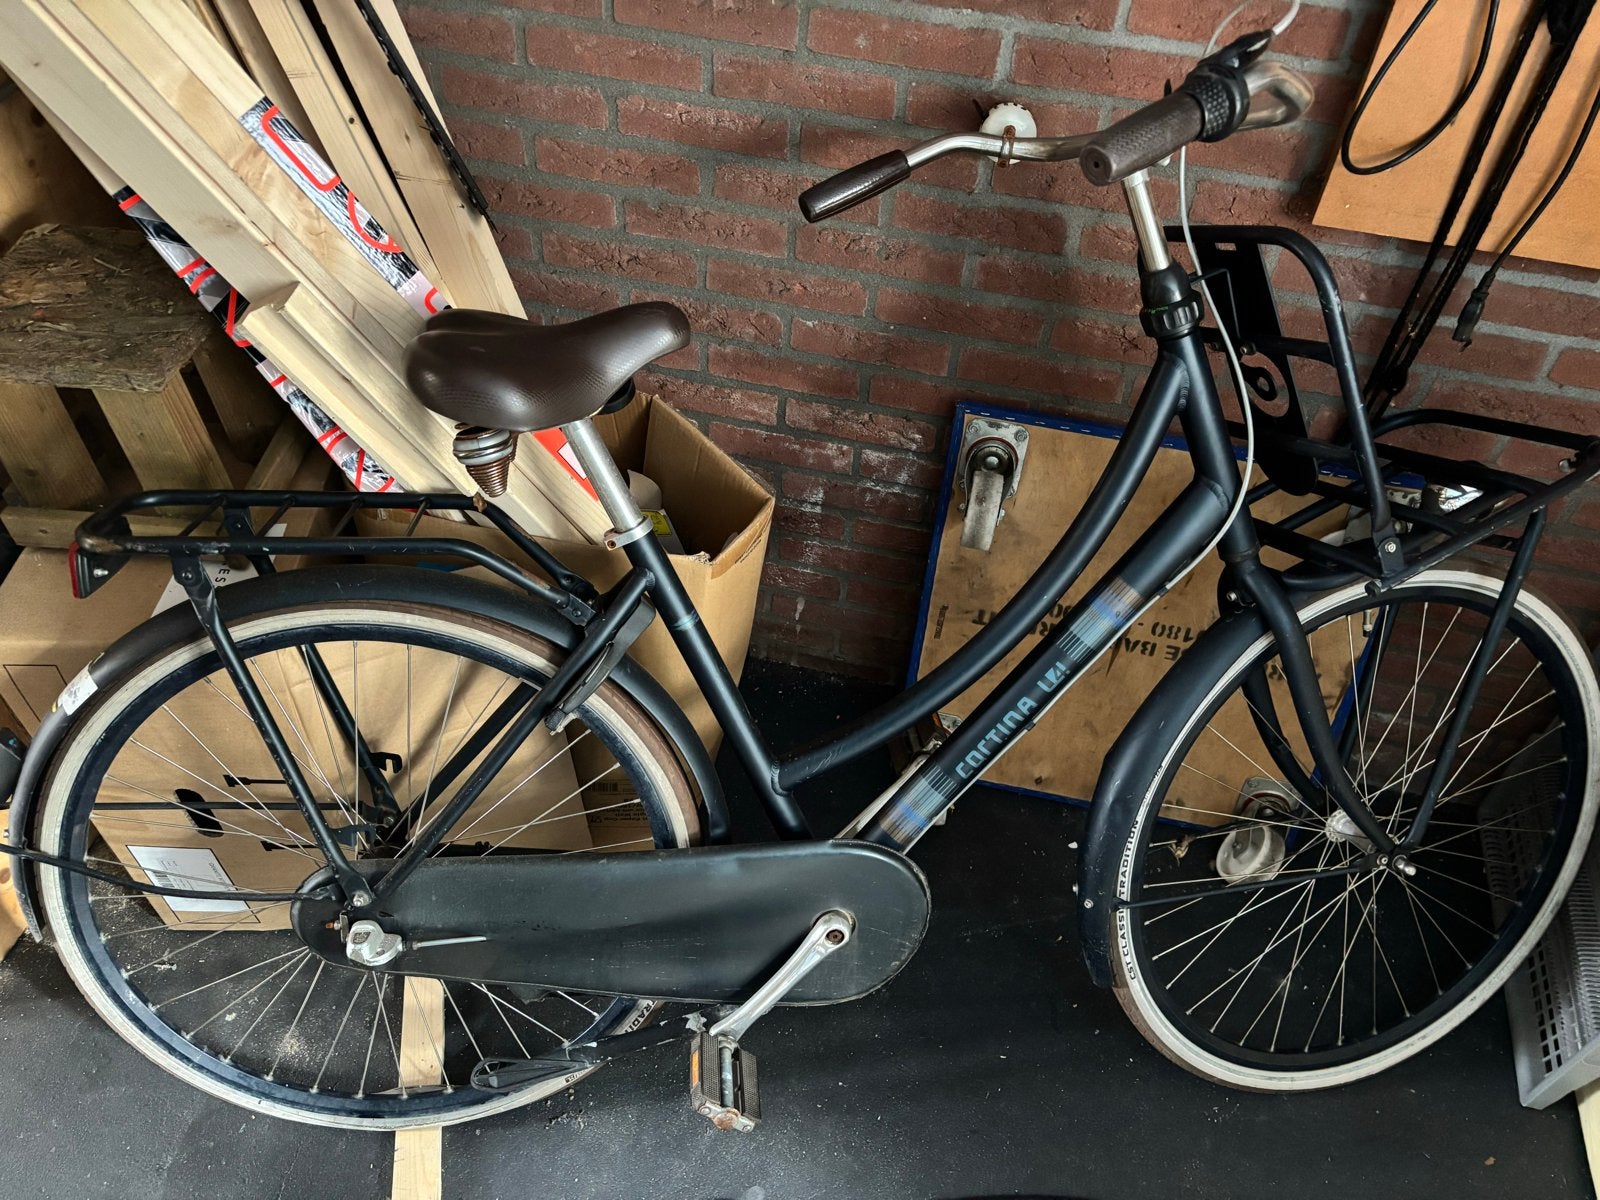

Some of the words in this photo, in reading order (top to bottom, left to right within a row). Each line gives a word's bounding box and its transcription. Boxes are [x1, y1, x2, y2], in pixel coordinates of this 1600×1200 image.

[955, 697, 1038, 779] CORTINA
[1118, 908, 1129, 956] CLASSI
[1126, 961, 1136, 980] CST
